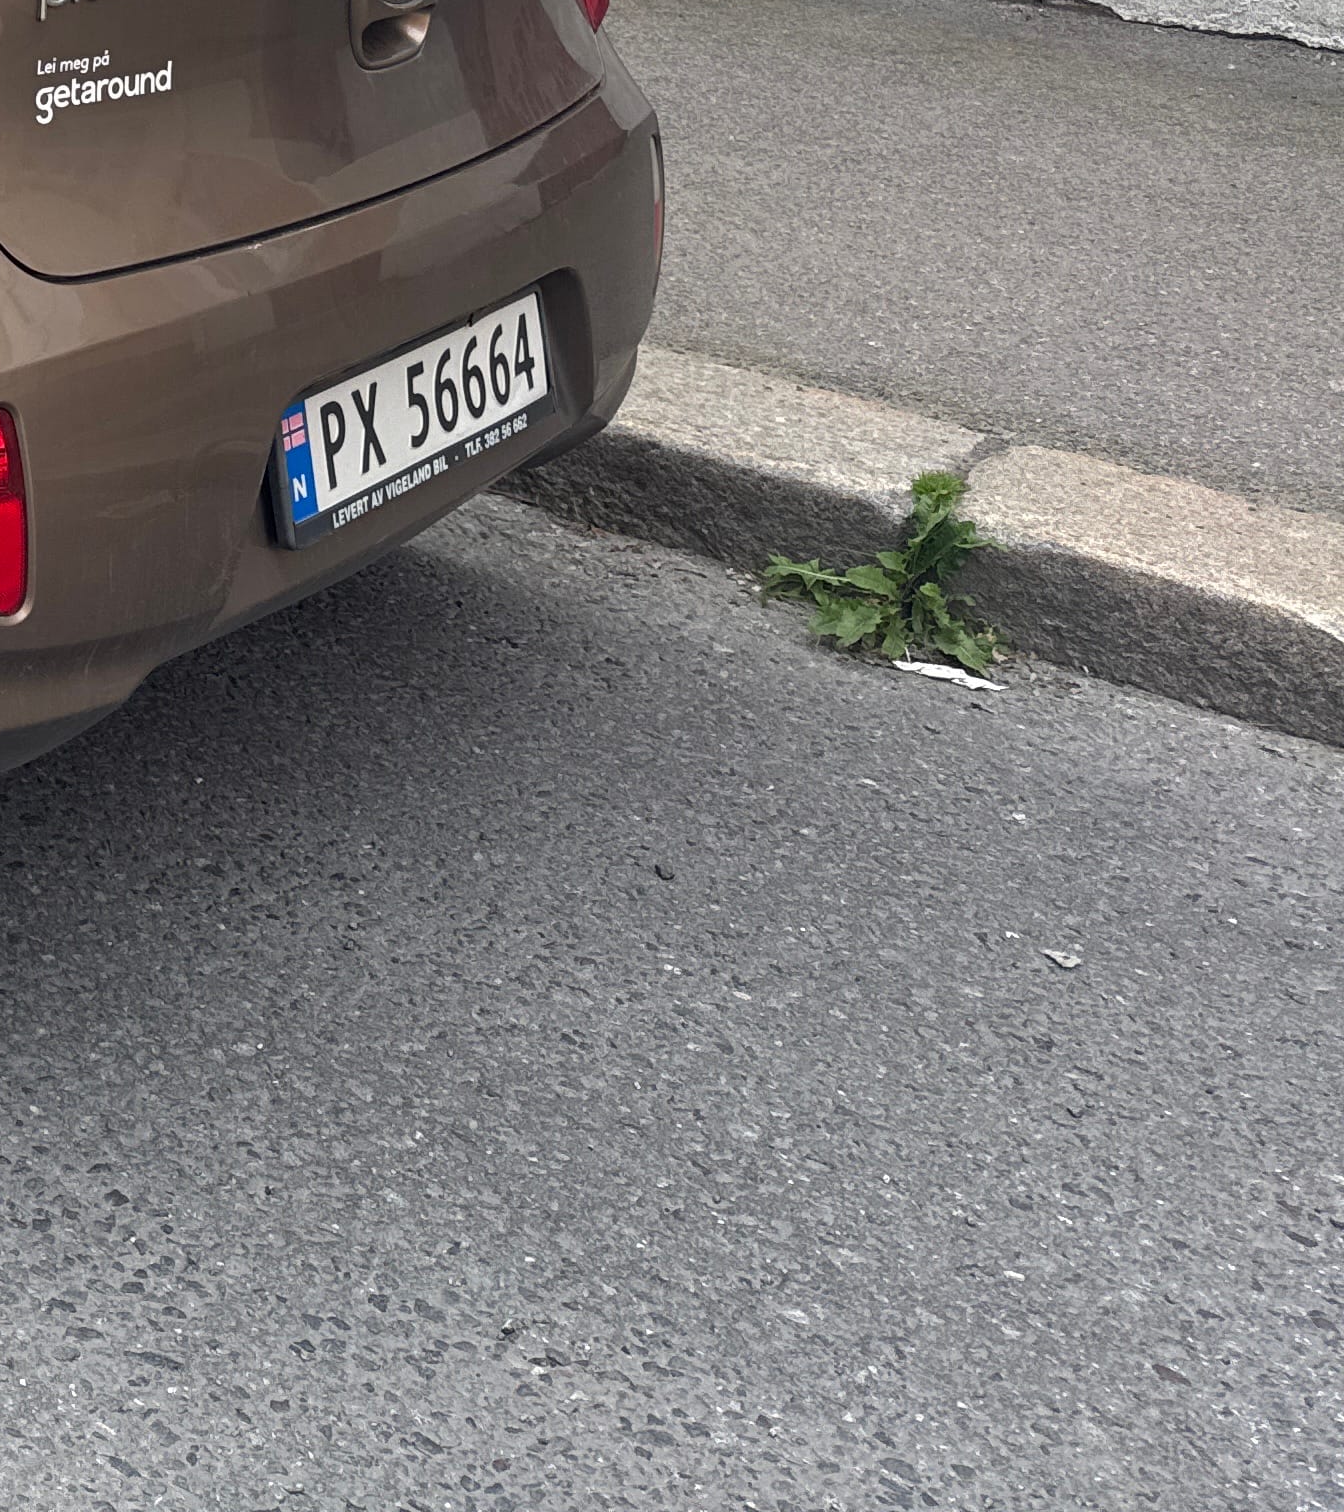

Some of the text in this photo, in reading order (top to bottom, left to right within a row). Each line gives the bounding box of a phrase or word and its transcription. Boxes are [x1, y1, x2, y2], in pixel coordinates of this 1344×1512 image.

[35, 60, 173, 125] getaround
[37, 57, 57, 75] Lei
[59, 57, 89, 74] meg
[319, 312, 536, 491] PX 56664
[291, 473, 308, 502] N
[332, 495, 370, 529] LEVERT
[370, 488, 385, 508] AV
[384, 463, 432, 500] VIGELAND
[432, 455, 449, 476] BIL
[484, 431, 501, 449] 382
[500, 422, 513, 441] 56
